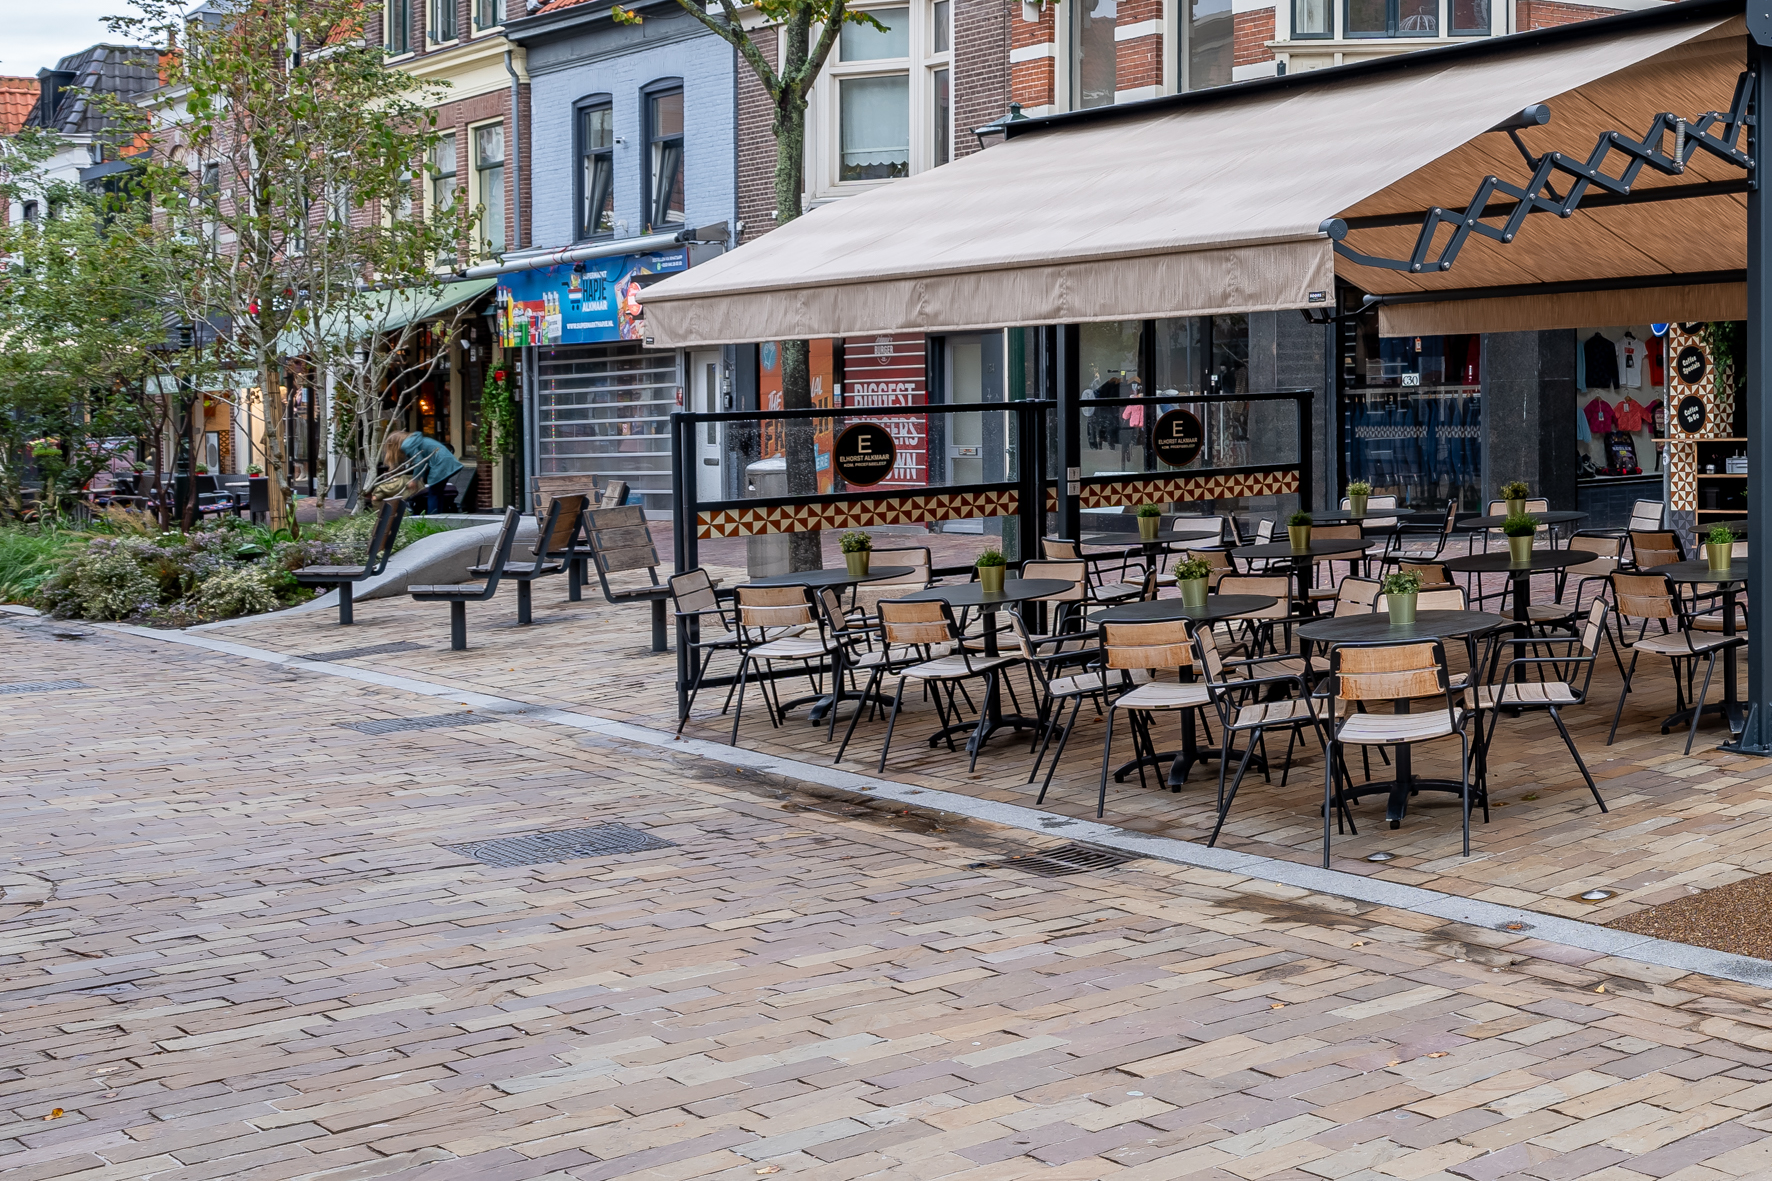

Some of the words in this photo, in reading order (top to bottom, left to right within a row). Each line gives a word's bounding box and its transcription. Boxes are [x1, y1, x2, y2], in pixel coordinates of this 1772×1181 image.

[583, 278, 606, 301] HAPJE
[582, 300, 608, 312] ALKMAAR
[874, 345, 893, 355] BURGER
[1682, 355, 1696, 366] Coffee
[1682, 361, 1700, 375] Specials
[854, 383, 915, 406] BIGGEST
[1684, 406, 1699, 416] Coffee
[1687, 415, 1693, 423] To
[1692, 413, 1699, 421] Go
[1173, 421, 1183, 437] E
[858, 435, 872, 453] E
